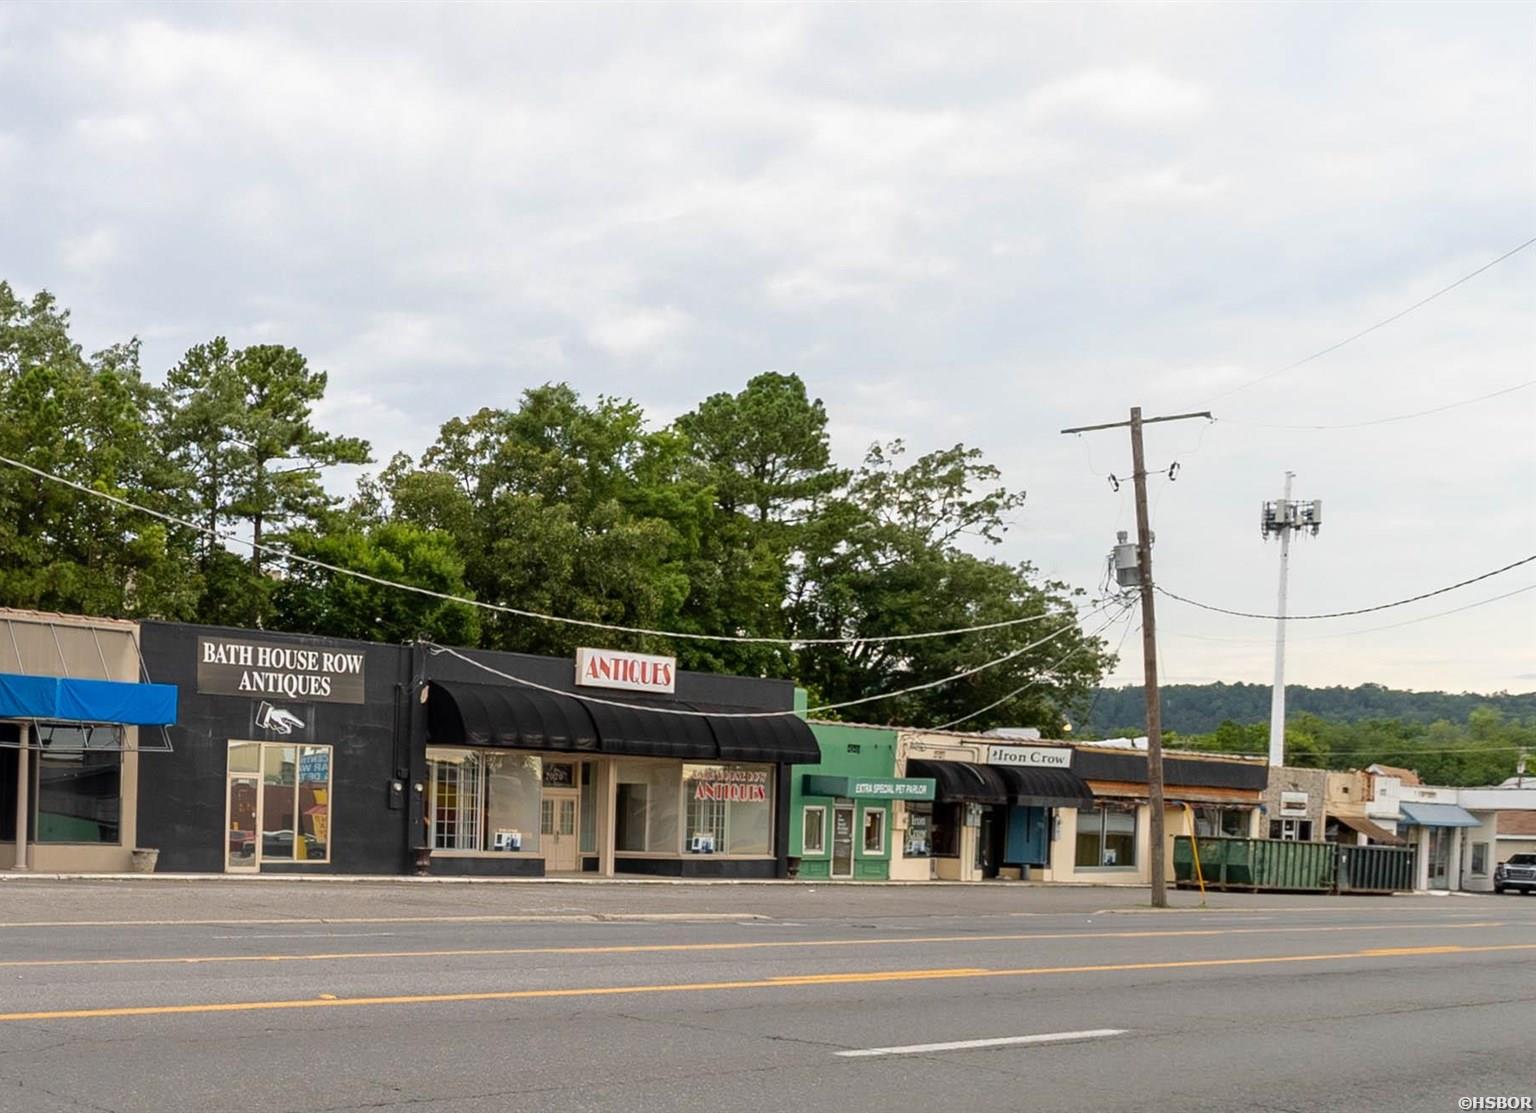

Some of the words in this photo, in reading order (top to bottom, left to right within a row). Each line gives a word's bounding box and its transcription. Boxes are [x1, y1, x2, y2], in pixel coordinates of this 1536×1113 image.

[202, 641, 253, 667] BATH
[257, 646, 320, 672] HOUSE
[322, 652, 364, 674] ROW
[585, 655, 672, 687] ANTIQUES
[238, 670, 332, 698] ANTIQUES
[998, 749, 1027, 763] Iron
[1030, 751, 1066, 764] Crow
[694, 782, 766, 802] ANTIQUES
[855, 783, 873, 794] EXTRA
[873, 783, 895, 795] SPECIAL
[895, 784, 905, 795] PET
[906, 784, 928, 795] PARLOR
